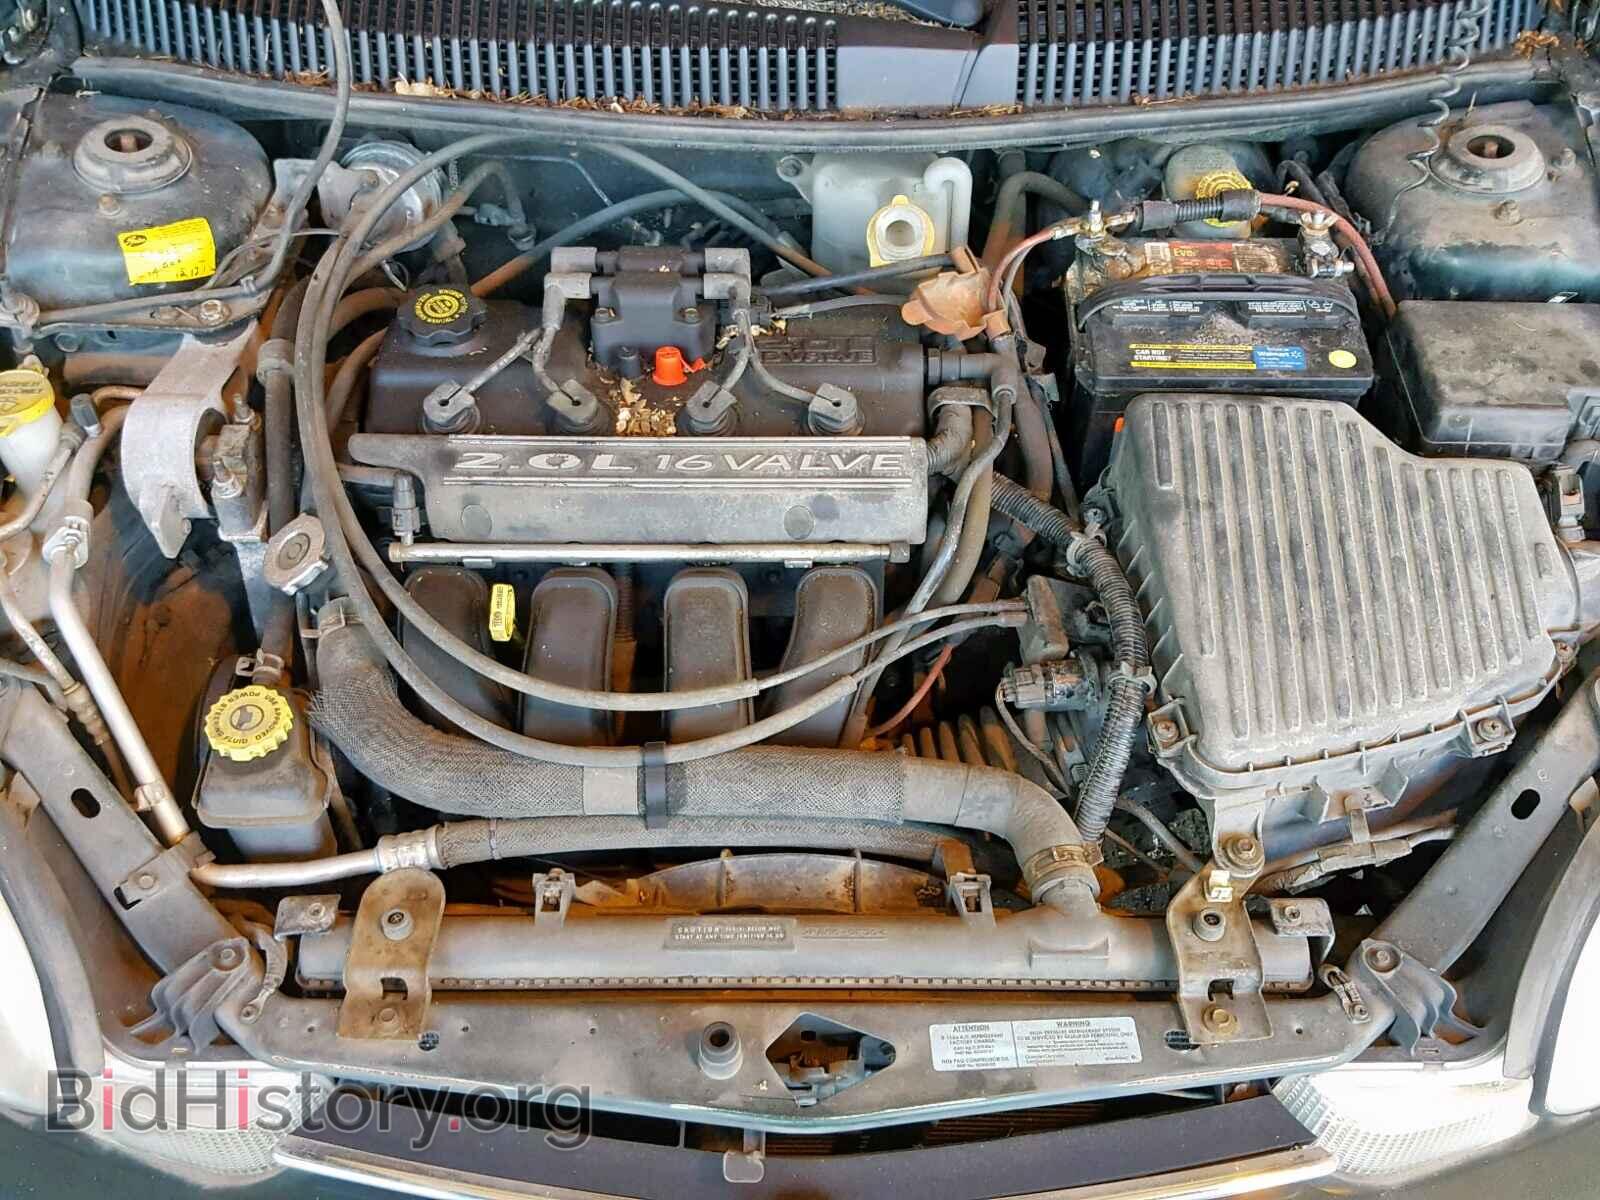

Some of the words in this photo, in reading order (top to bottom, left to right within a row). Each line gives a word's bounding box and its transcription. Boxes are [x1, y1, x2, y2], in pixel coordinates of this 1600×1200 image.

[455, 453, 635, 471] 2.0L
[721, 454, 905, 472] VALVE
[228, 691, 261, 703] POWER
[223, 735, 249, 745] FLUID
[678, 926, 721, 934] CAUTION
[953, 1024, 990, 1033] ATTENTION
[1056, 1020, 1090, 1028] WARNING
